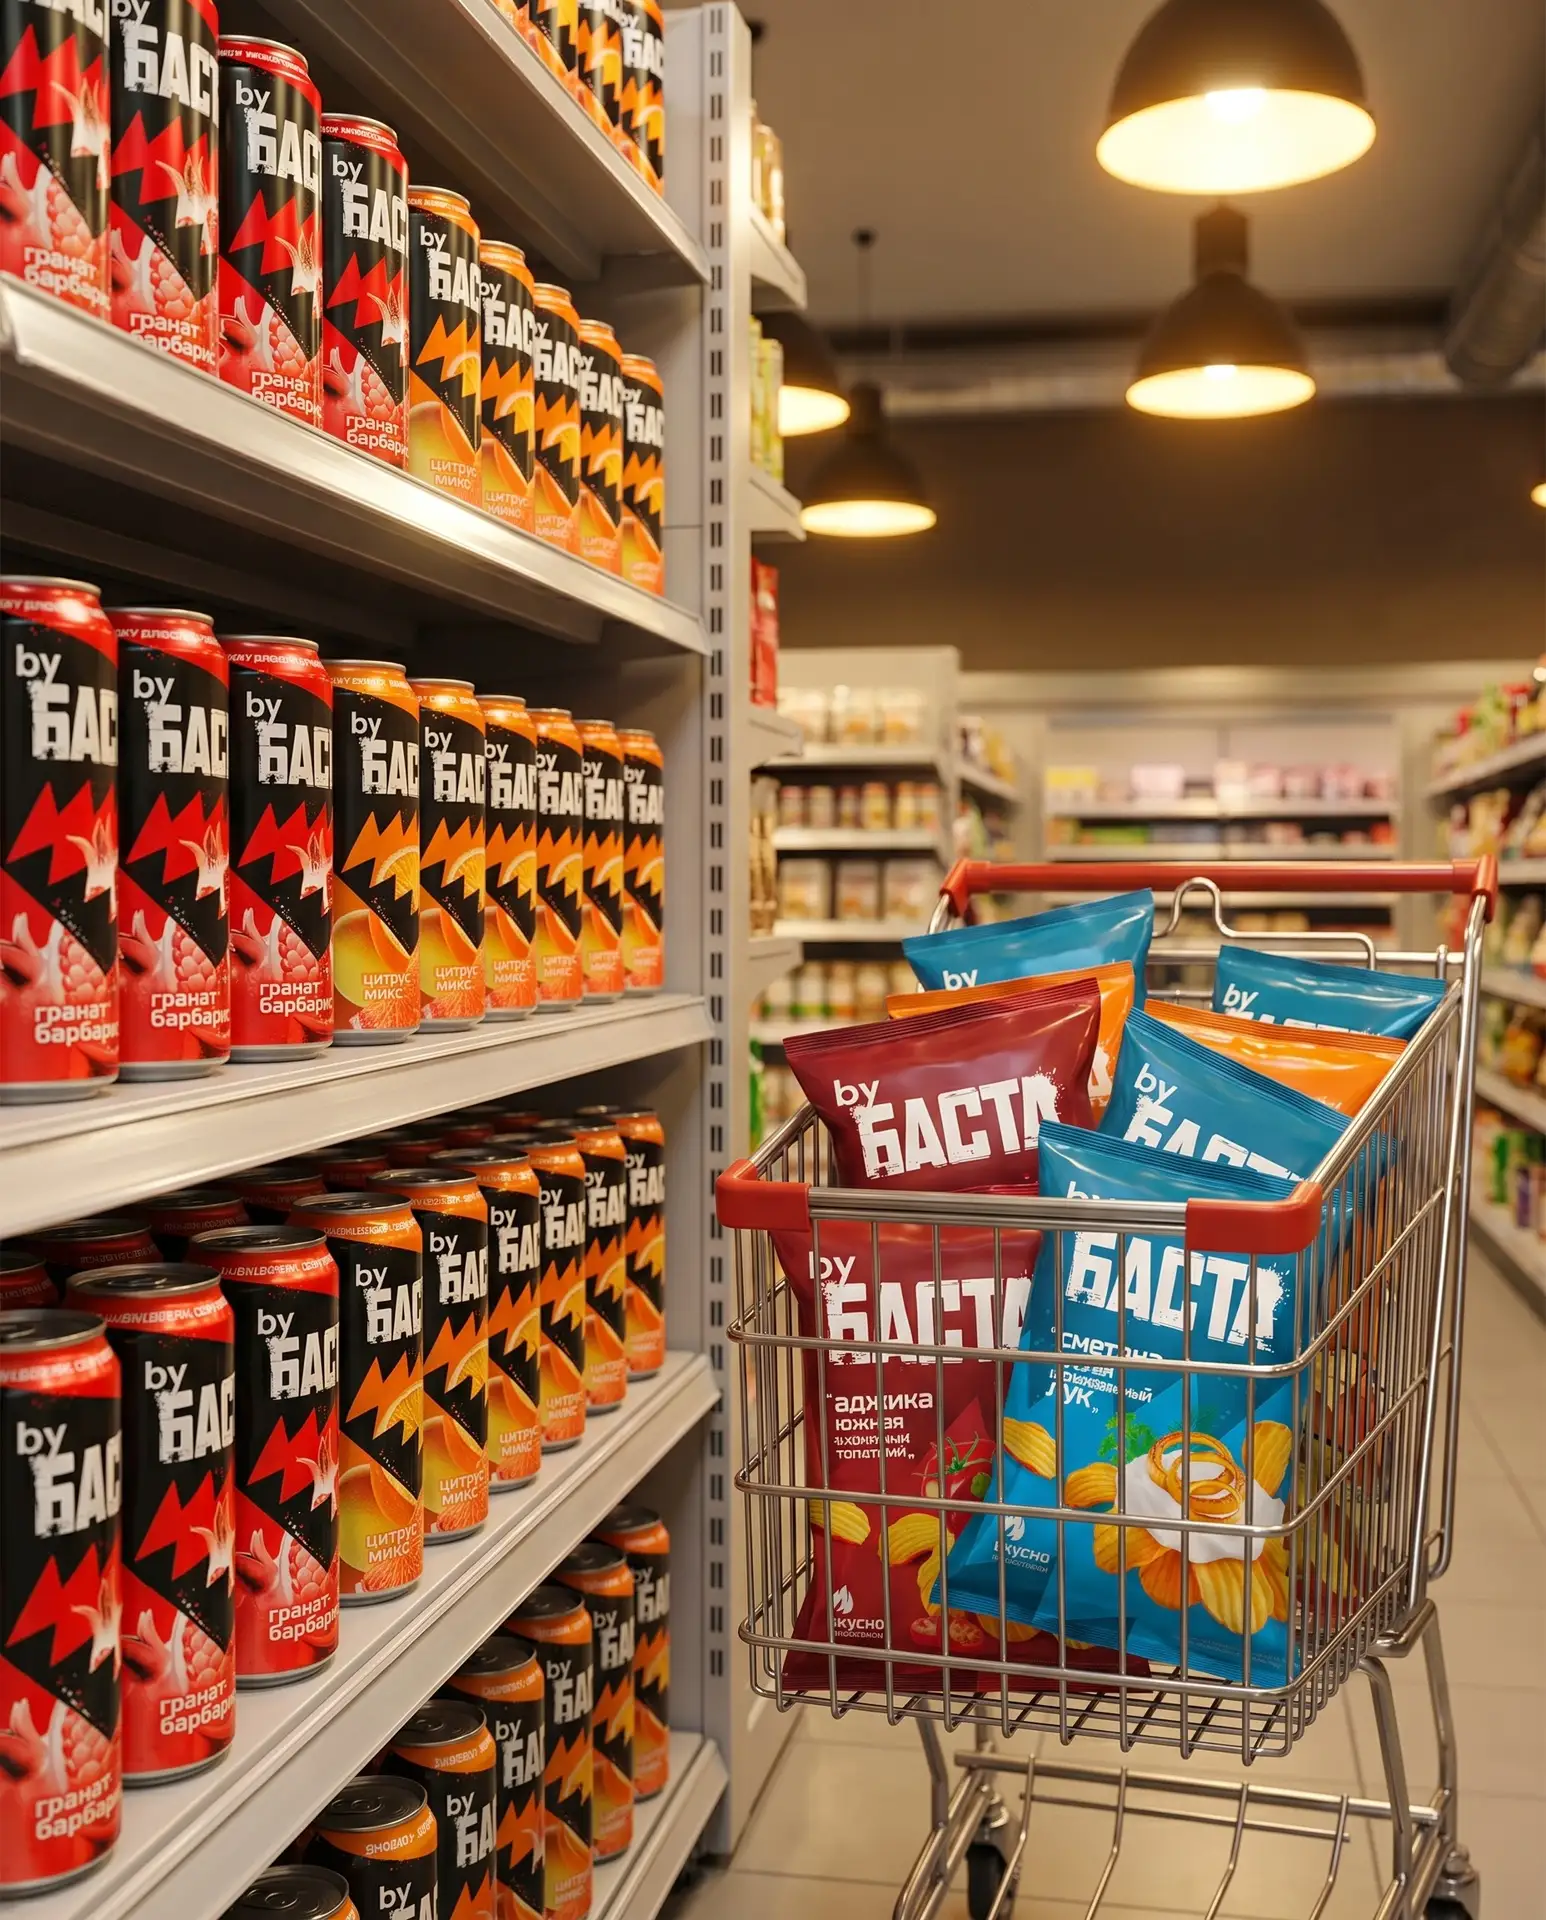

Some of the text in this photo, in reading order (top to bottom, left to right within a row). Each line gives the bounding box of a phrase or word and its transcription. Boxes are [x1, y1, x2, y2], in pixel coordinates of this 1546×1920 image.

[235, 80, 270, 113] by
[332, 153, 364, 184] by
[420, 225, 447, 252] by
[24, 247, 97, 280] гранат
[130, 313, 200, 339] гранат
[251, 371, 311, 395] гранат
[346, 415, 400, 436] гранат
[15, 643, 62, 686] by
[133, 669, 175, 706] by
[246, 691, 282, 725] by
[351, 711, 382, 741] by
[424, 727, 453, 752] by
[484, 740, 508, 763] by
[623, 764, 645, 785] by
[259, 981, 320, 998] гранат
[1222, 983, 1259, 1012] by
[834, 1080, 880, 1108] by
[1134, 1063, 1178, 1107] by
[850, 1067, 1064, 1180] БАСТА
[490, 1206, 517, 1229] by
[430, 1231, 458, 1257] by
[355, 1264, 388, 1291] by
[808, 1251, 856, 1285] by
[1065, 1231, 1290, 1353] БАСТА
[257, 1309, 295, 1340] by
[145, 1361, 189, 1393] by
[17, 1421, 68, 1459] by
[593, 1611, 618, 1630] by
[546, 1660, 572, 1681] by
[495, 1719, 522, 1742] by
[446, 1792, 475, 1819] by
[379, 1882, 412, 1911] by
